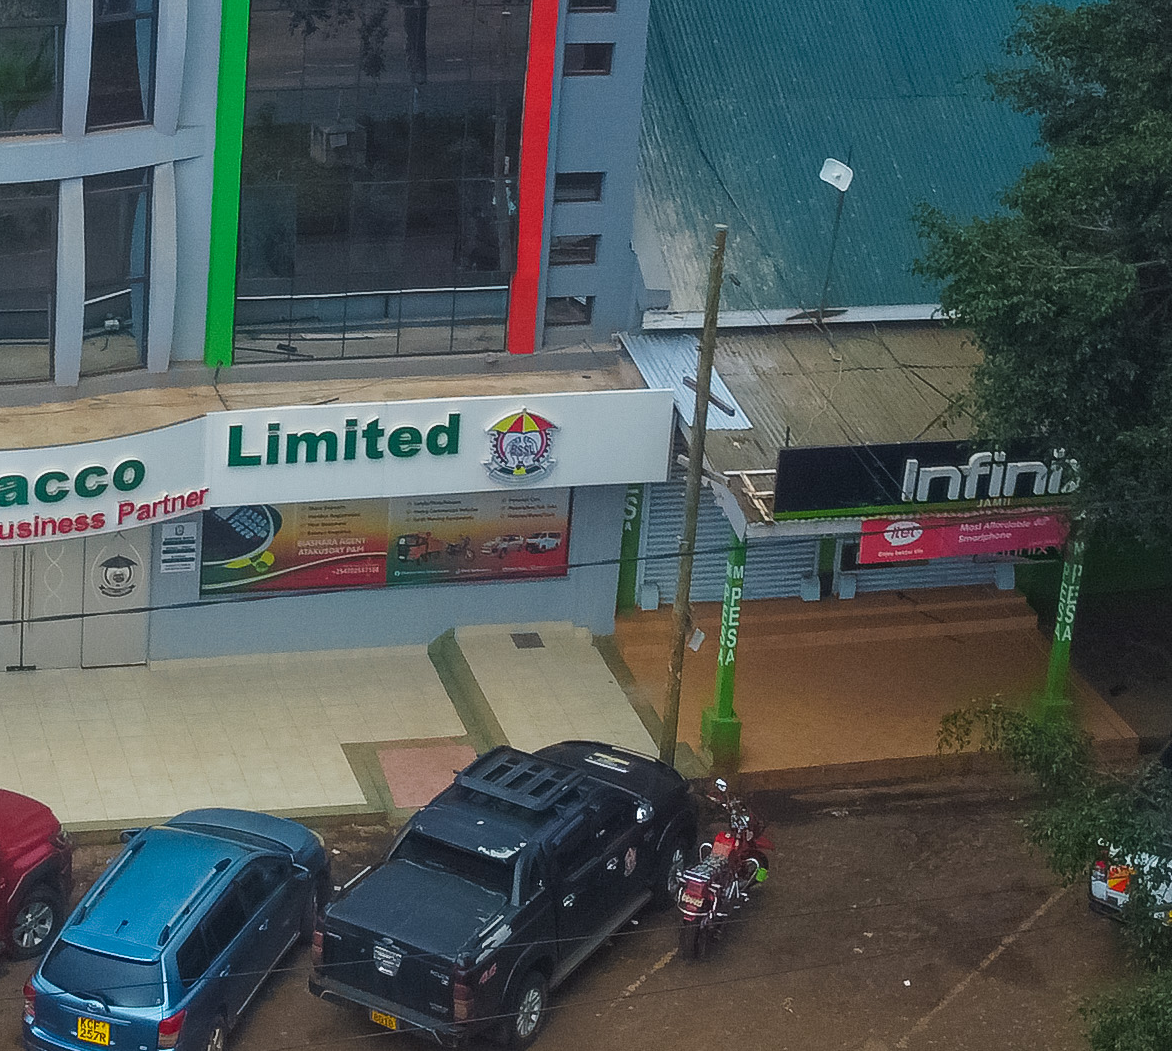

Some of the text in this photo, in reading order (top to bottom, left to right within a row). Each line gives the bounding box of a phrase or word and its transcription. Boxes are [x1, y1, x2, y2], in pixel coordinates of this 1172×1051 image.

[228, 411, 462, 467] Limited
[117, 486, 210, 525] Partner
[960, 523, 982, 532] Most
[983, 520, 1030, 531] Affordable
[339, 537, 367, 546] AGENT
[958, 532, 1013, 543] Smartphone
